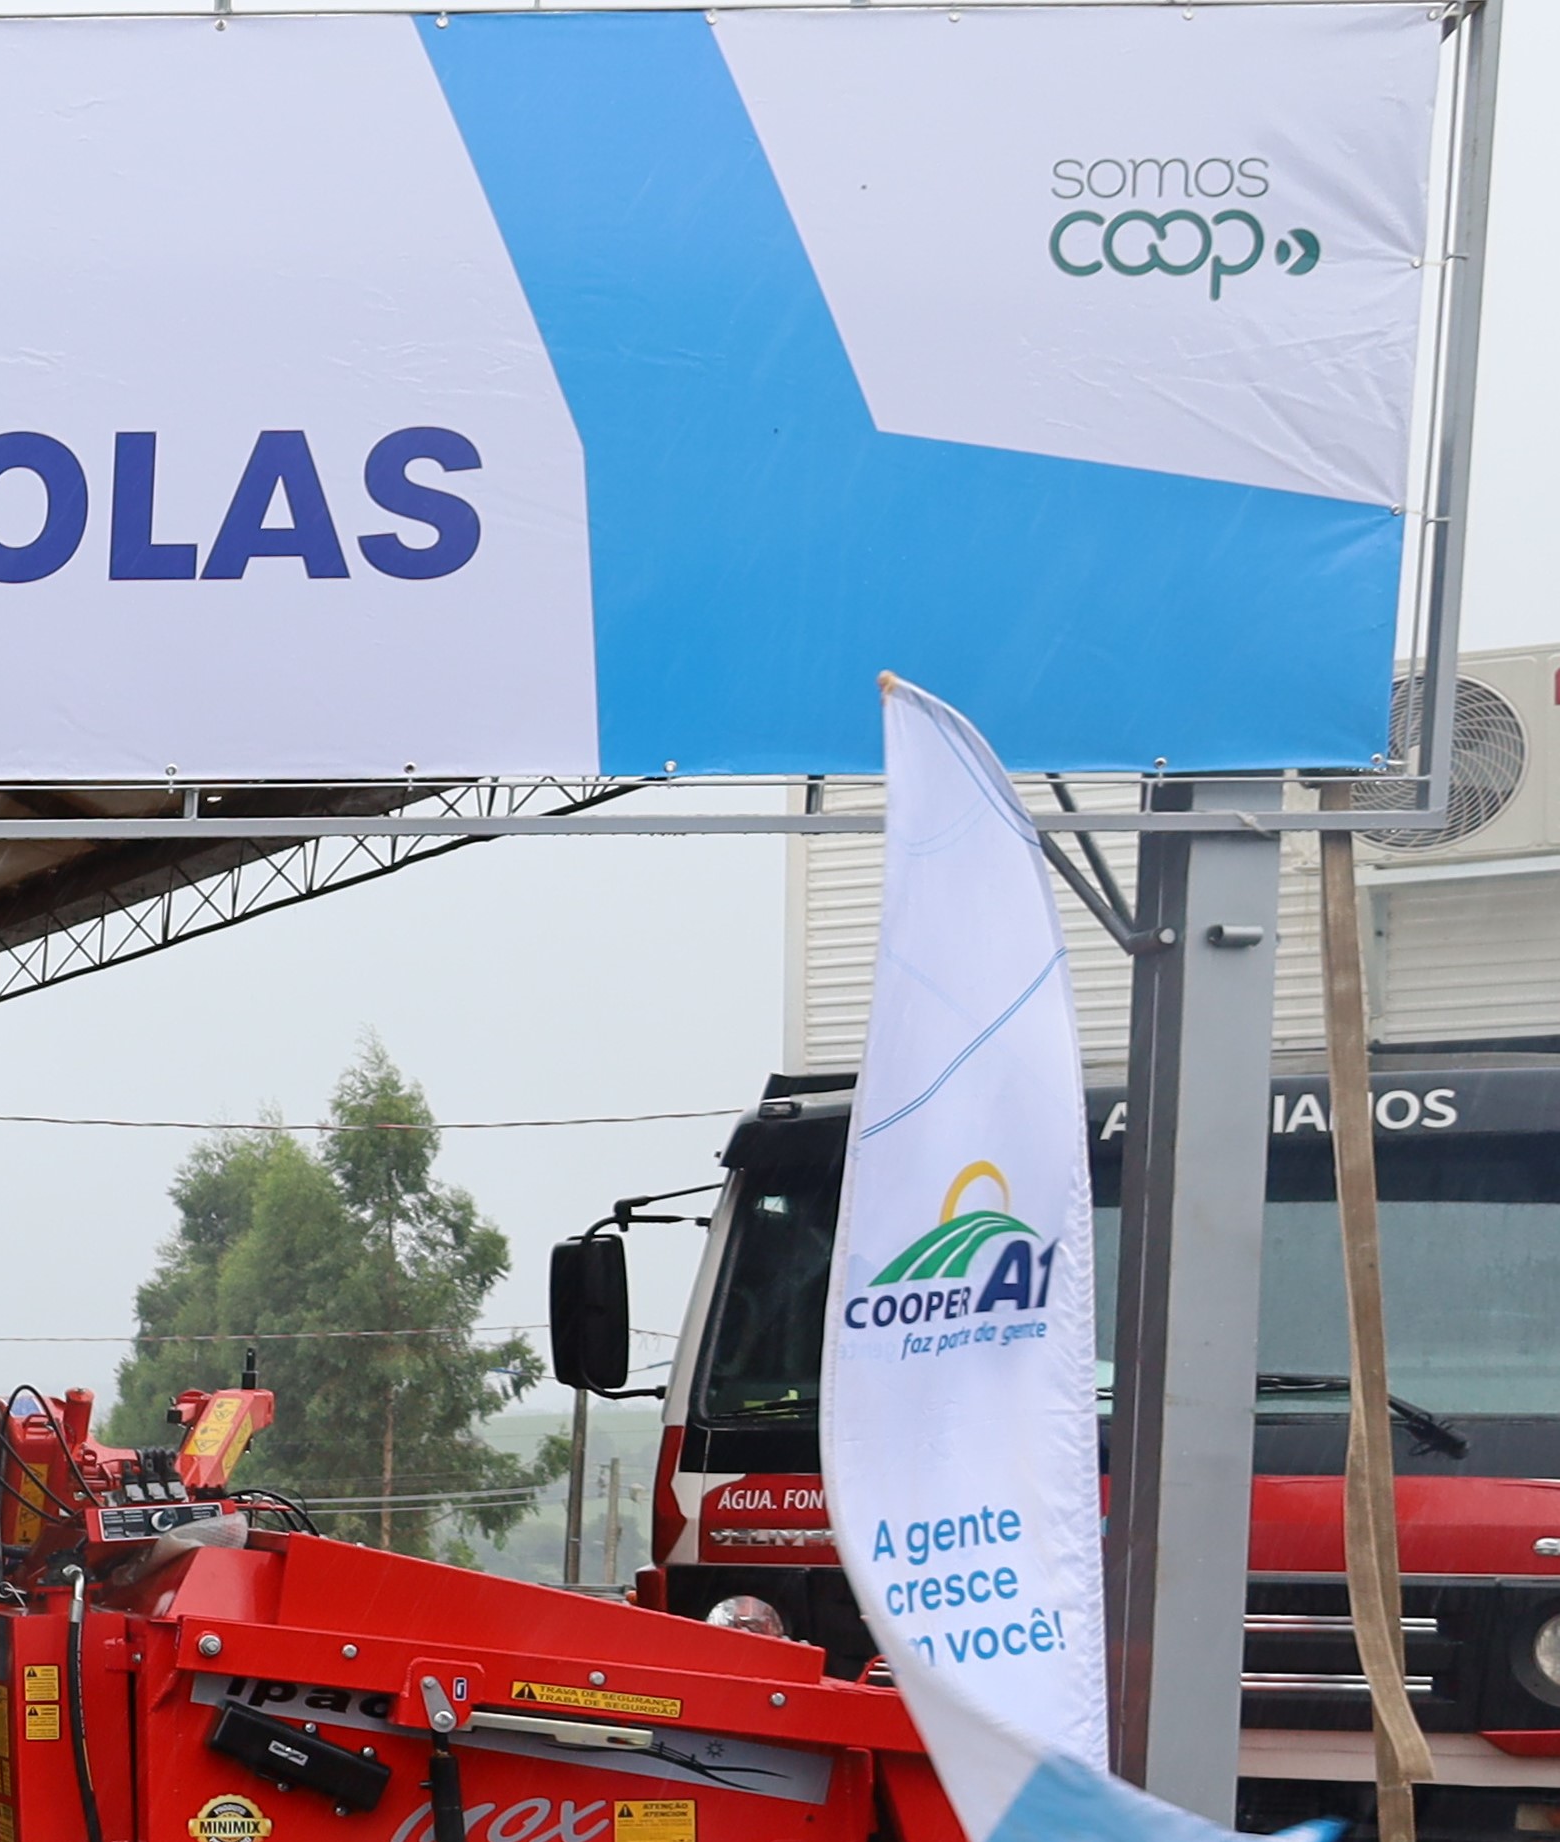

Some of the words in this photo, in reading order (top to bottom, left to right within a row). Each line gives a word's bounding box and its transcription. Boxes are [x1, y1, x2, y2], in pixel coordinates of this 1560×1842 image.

[1051, 157, 1268, 199] somos
[1049, 209, 1265, 301] coop
[844, 1286, 972, 1329] COOPER
[974, 1238, 1059, 1314] A1
[901, 1332, 935, 1360] faz
[974, 1321, 997, 1342] da
[1001, 1319, 1048, 1346] gente
[717, 1486, 778, 1510] ÁGUA.
[873, 1519, 896, 1562] A
[905, 1505, 1021, 1566] gente
[886, 1566, 1019, 1617] cresce
[944, 1607, 1067, 1664] você!
[539, 1685, 578, 1698] TRAVA
[581, 1689, 598, 1699] DE
[601, 1692, 678, 1709] SEGURANÇA
[539, 1693, 581, 1706] TRABA
[584, 1699, 601, 1708] DE
[604, 1700, 679, 1717] SEGURIDAD
[199, 1821, 261, 1834] MINIMIX
